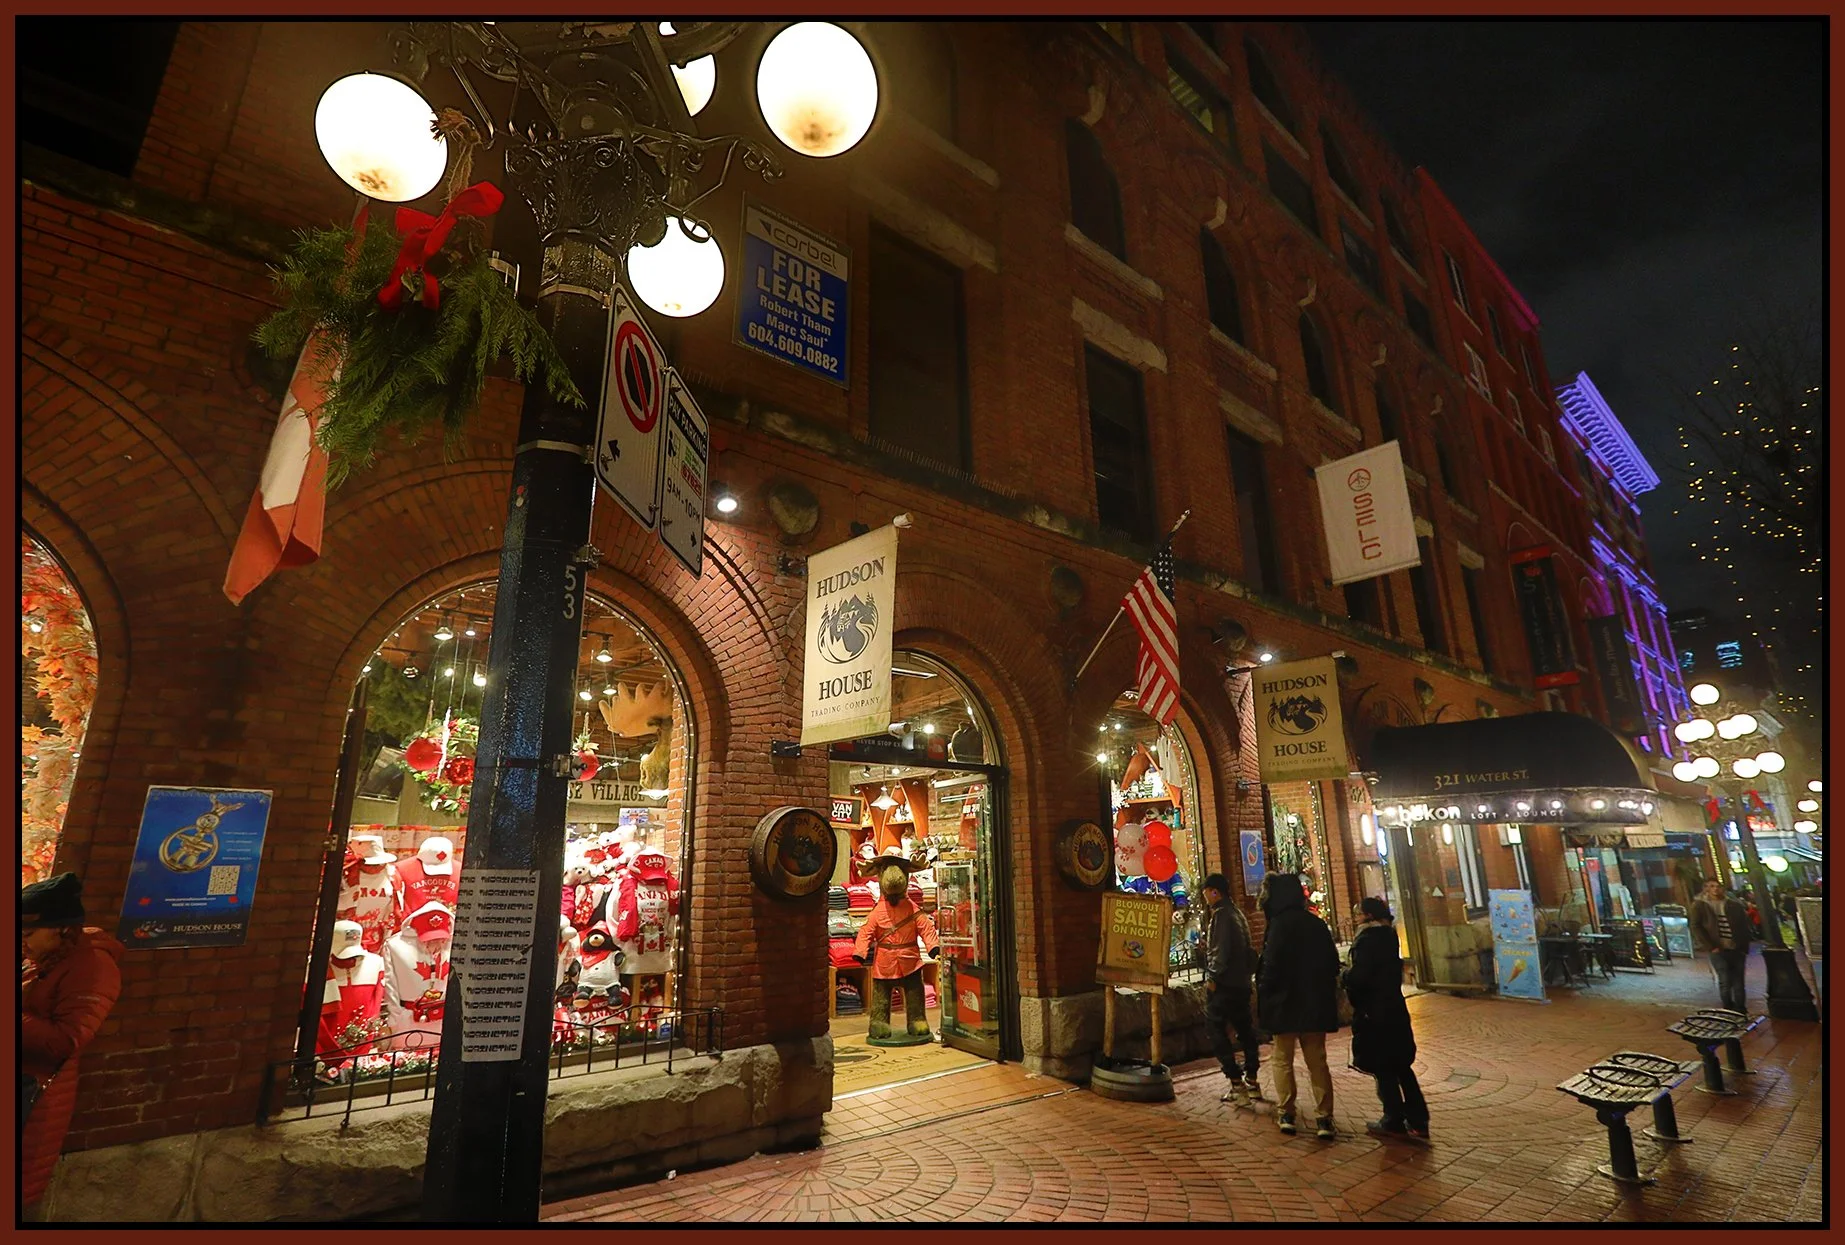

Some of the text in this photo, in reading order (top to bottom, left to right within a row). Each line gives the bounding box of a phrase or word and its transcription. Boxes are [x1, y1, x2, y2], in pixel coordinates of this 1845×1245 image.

[773, 226, 837, 270] corbel
[772, 249, 821, 292] FOR
[757, 266, 835, 322] LEASE
[760, 294, 832, 336] Robert Tham
[766, 313, 797, 337] Marc
[748, 321, 838, 374] 604.609.0882
[816, 556, 886, 599] HUDSON
[818, 669, 873, 701] HOUSE
[1262, 673, 1328, 695] HUDSON
[811, 695, 881, 718] TRADING COMPANY
[1273, 740, 1328, 758] HOUSE
[1433, 769, 1530, 791] 321 WATER ST.
[591, 783, 646, 801] VILLAGE
[831, 811, 853, 819] CITY
[832, 802, 853, 811] VAN
[1471, 812, 1497, 820] LOFT
[1516, 809, 1565, 818] LOUNGE
[1115, 900, 1160, 912] BLOWOUT
[173, 924, 212, 932] HUDSON
[214, 923, 241, 931] HOUSE
[1113, 908, 1159, 929] SALE
[1112, 926, 1158, 940] ON NOW!
